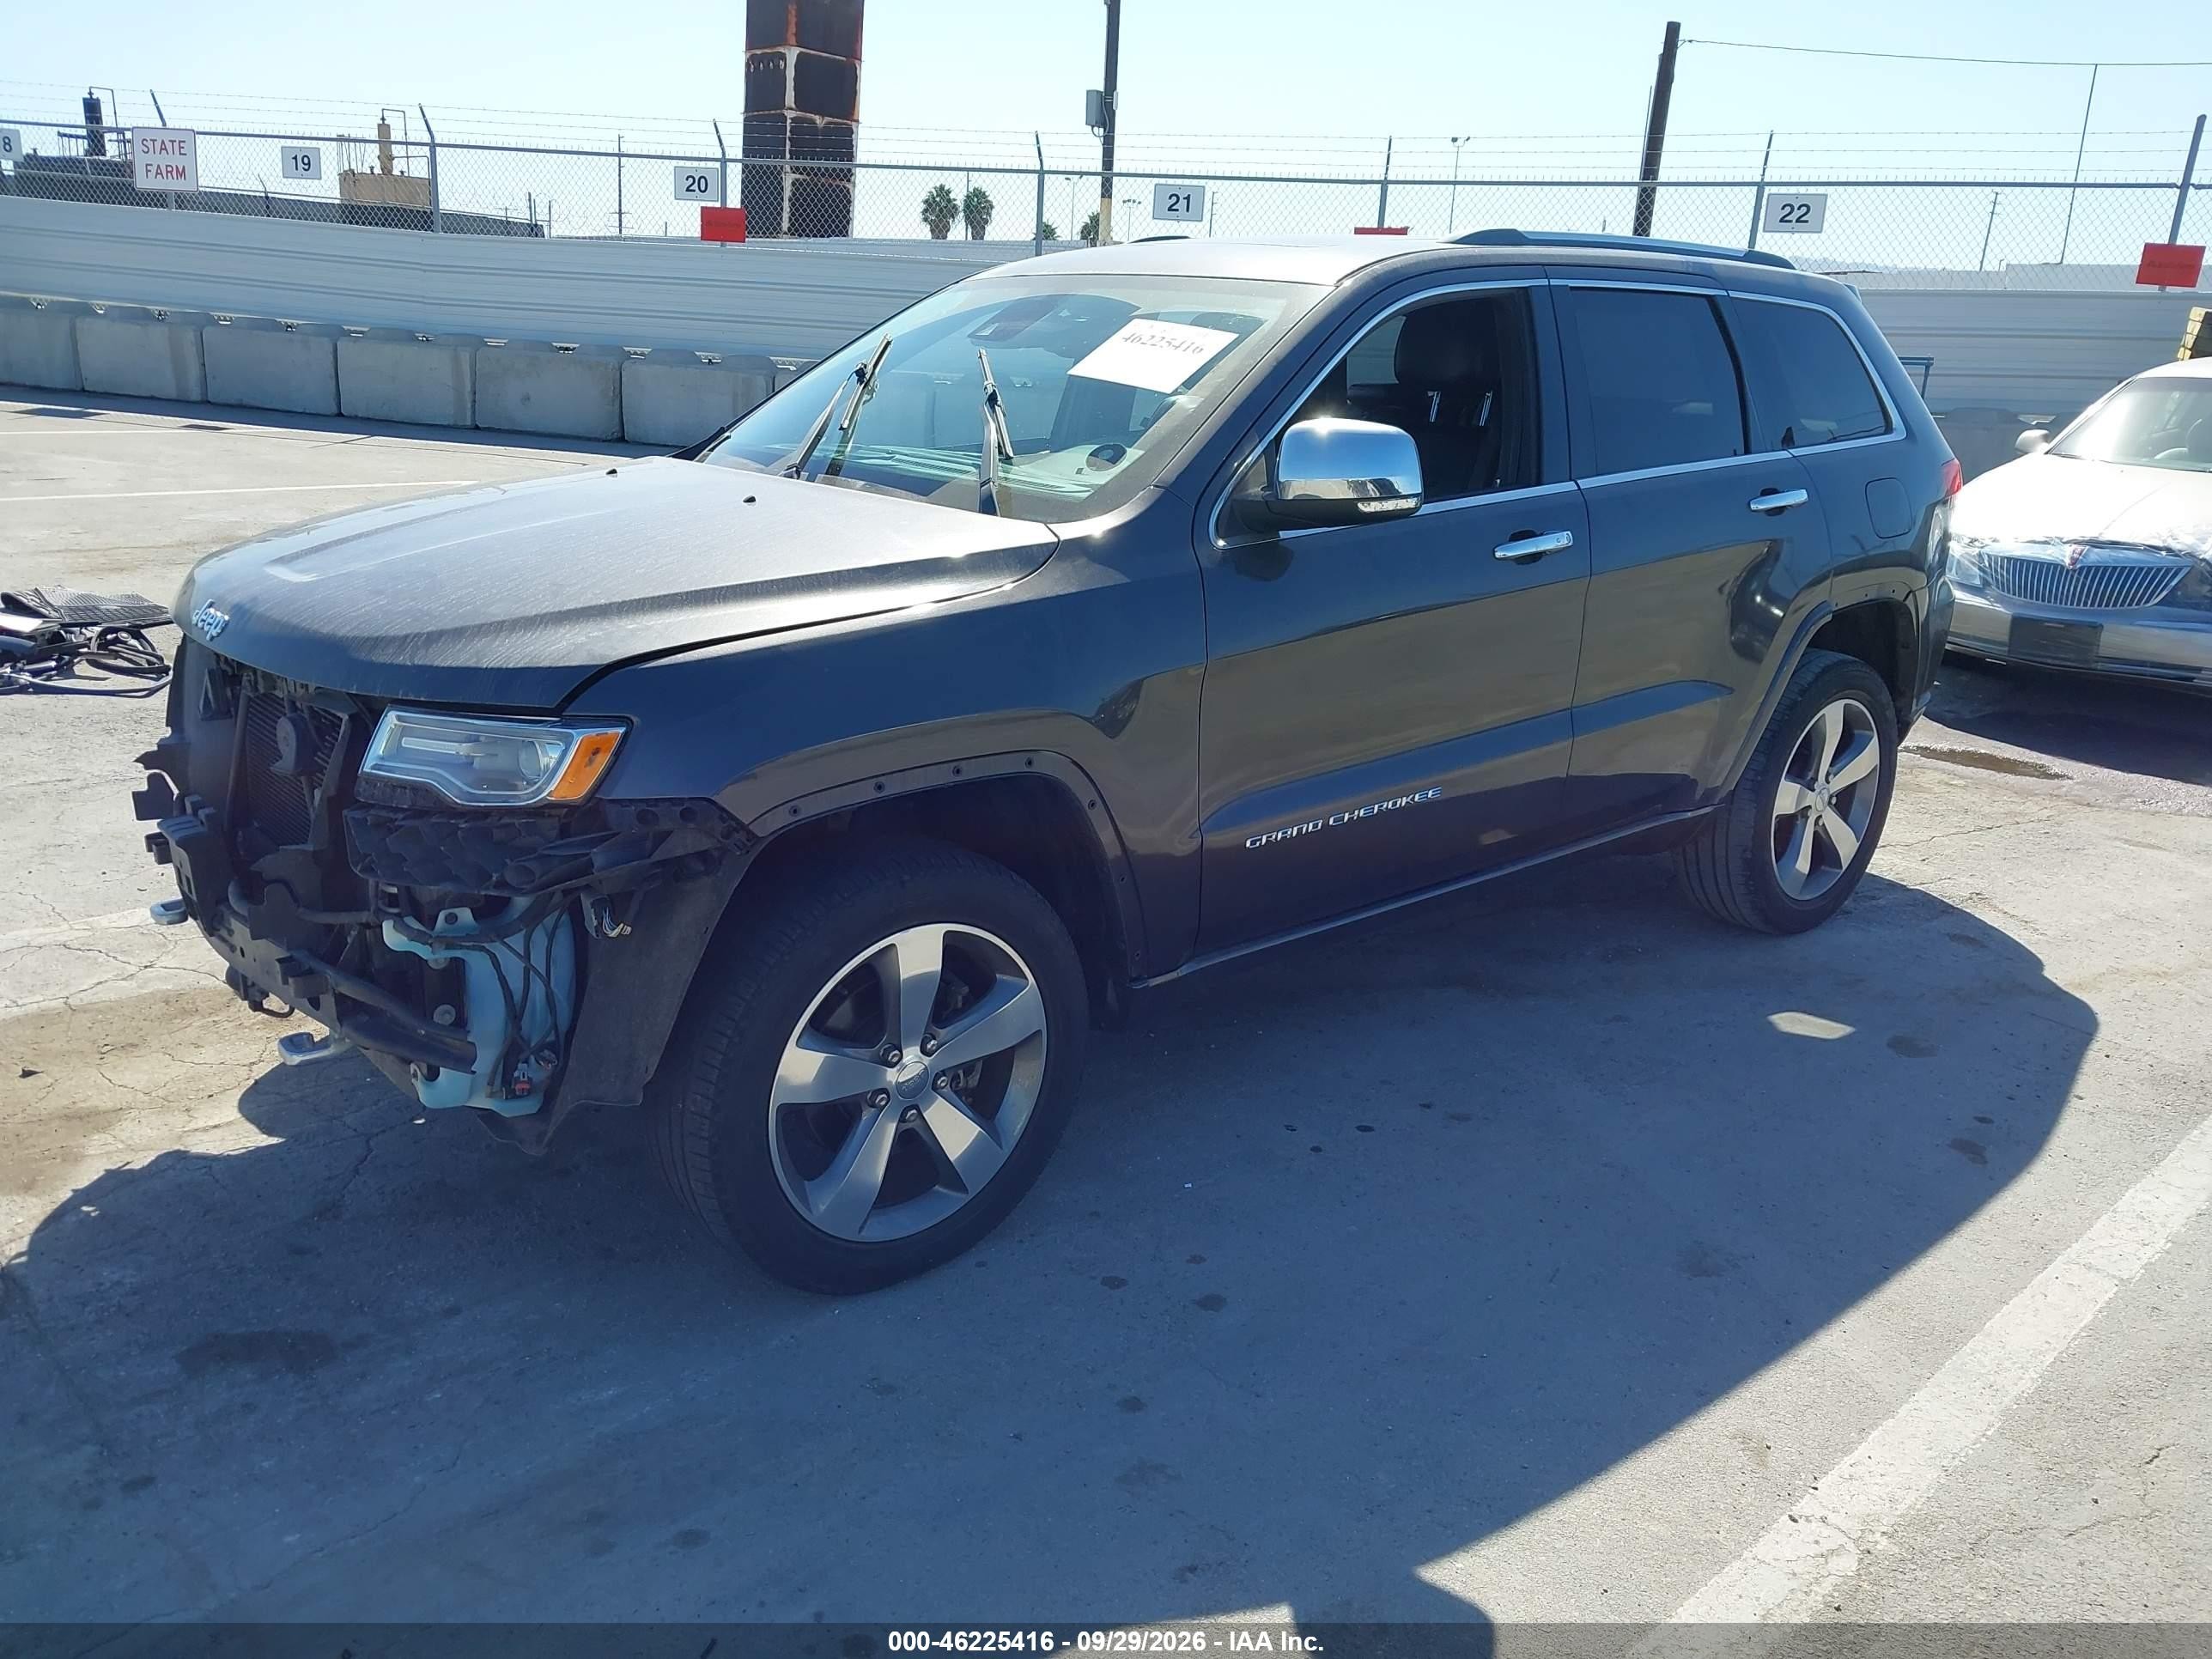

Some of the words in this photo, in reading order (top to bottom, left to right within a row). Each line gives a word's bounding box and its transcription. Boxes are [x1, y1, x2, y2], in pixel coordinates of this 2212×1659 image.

[140, 137, 188, 157] STATE
[144, 161, 187, 182] FARM
[290, 154, 312, 173] 19
[684, 174, 709, 194] 20
[1166, 191, 1192, 214] 21
[1778, 203, 1812, 225] 22
[1121, 331, 1205, 356] 46225416
[191, 599, 229, 641] Jeep
[1245, 818, 1323, 849] GRAND
[1328, 786, 1443, 827] CHEROKEE
